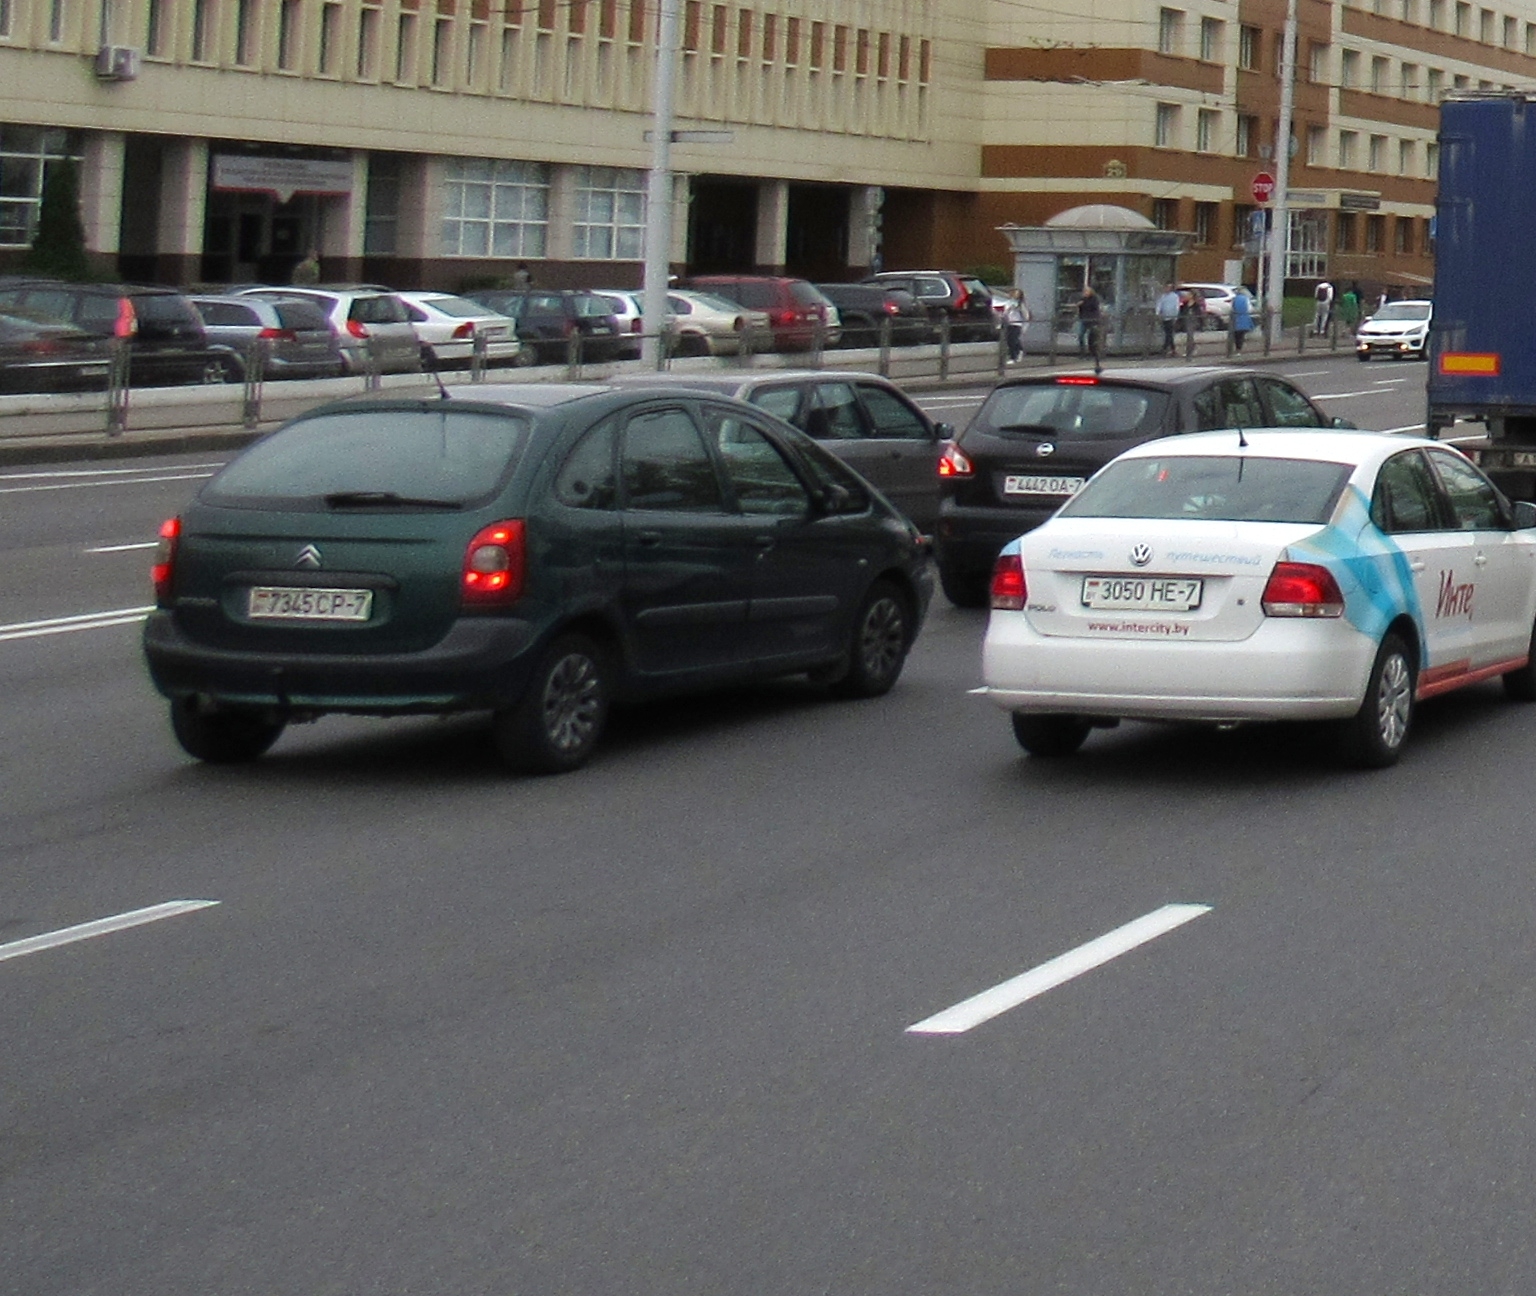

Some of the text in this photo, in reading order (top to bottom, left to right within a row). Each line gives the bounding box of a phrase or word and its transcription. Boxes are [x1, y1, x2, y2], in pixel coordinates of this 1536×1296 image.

[1254, 183, 1274, 193] STOP
[1101, 578, 1198, 602] 3050 HE-7
[269, 592, 366, 616] 7345 CP-7
[1087, 621, 1191, 636] www.intercity.by
